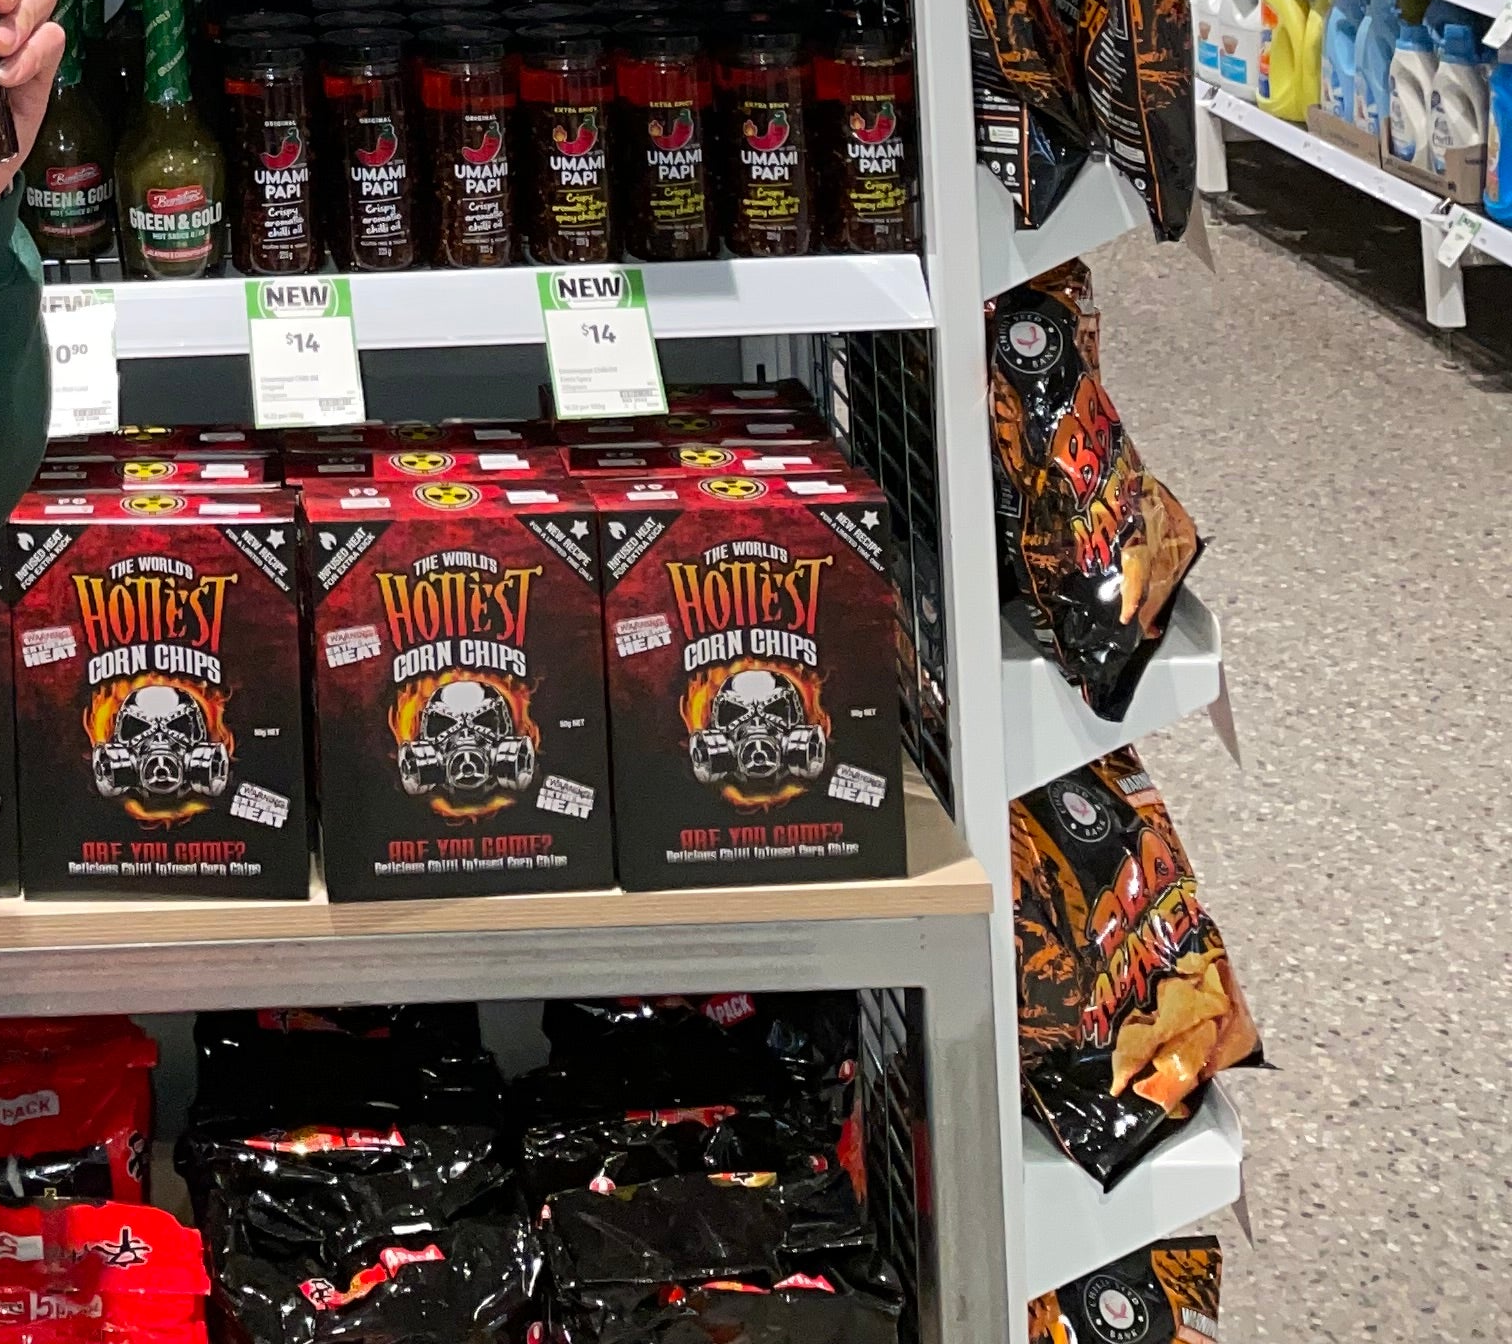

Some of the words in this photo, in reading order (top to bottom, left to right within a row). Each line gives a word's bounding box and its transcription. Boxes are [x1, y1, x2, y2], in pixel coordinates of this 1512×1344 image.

[741, 150, 798, 166] UMAMI
[752, 165, 789, 181] PAPI
[129, 206, 176, 232] GREEN
[177, 214, 190, 229] &
[191, 201, 223, 229] GOLD
[266, 286, 328, 307] NEW
[558, 277, 621, 298] NEW
[285, 332, 320, 353] $14
[581, 323, 616, 344] $14
[44, 528, 64, 551] HEAT
[20, 572, 35, 590] FOR
[33, 551, 56, 576] EXTRA
[53, 534, 73, 556] KICK
[241, 530, 261, 551] NEW
[259, 547, 289, 576] RECIPE
[109, 559, 134, 580] THE
[138, 557, 193, 580] WORLD'S
[89, 644, 147, 686] CORN
[155, 644, 221, 685] CHIPS
[82, 841, 123, 861] ARE
[131, 841, 167, 861] YOU
[175, 840, 246, 861] GAME?
